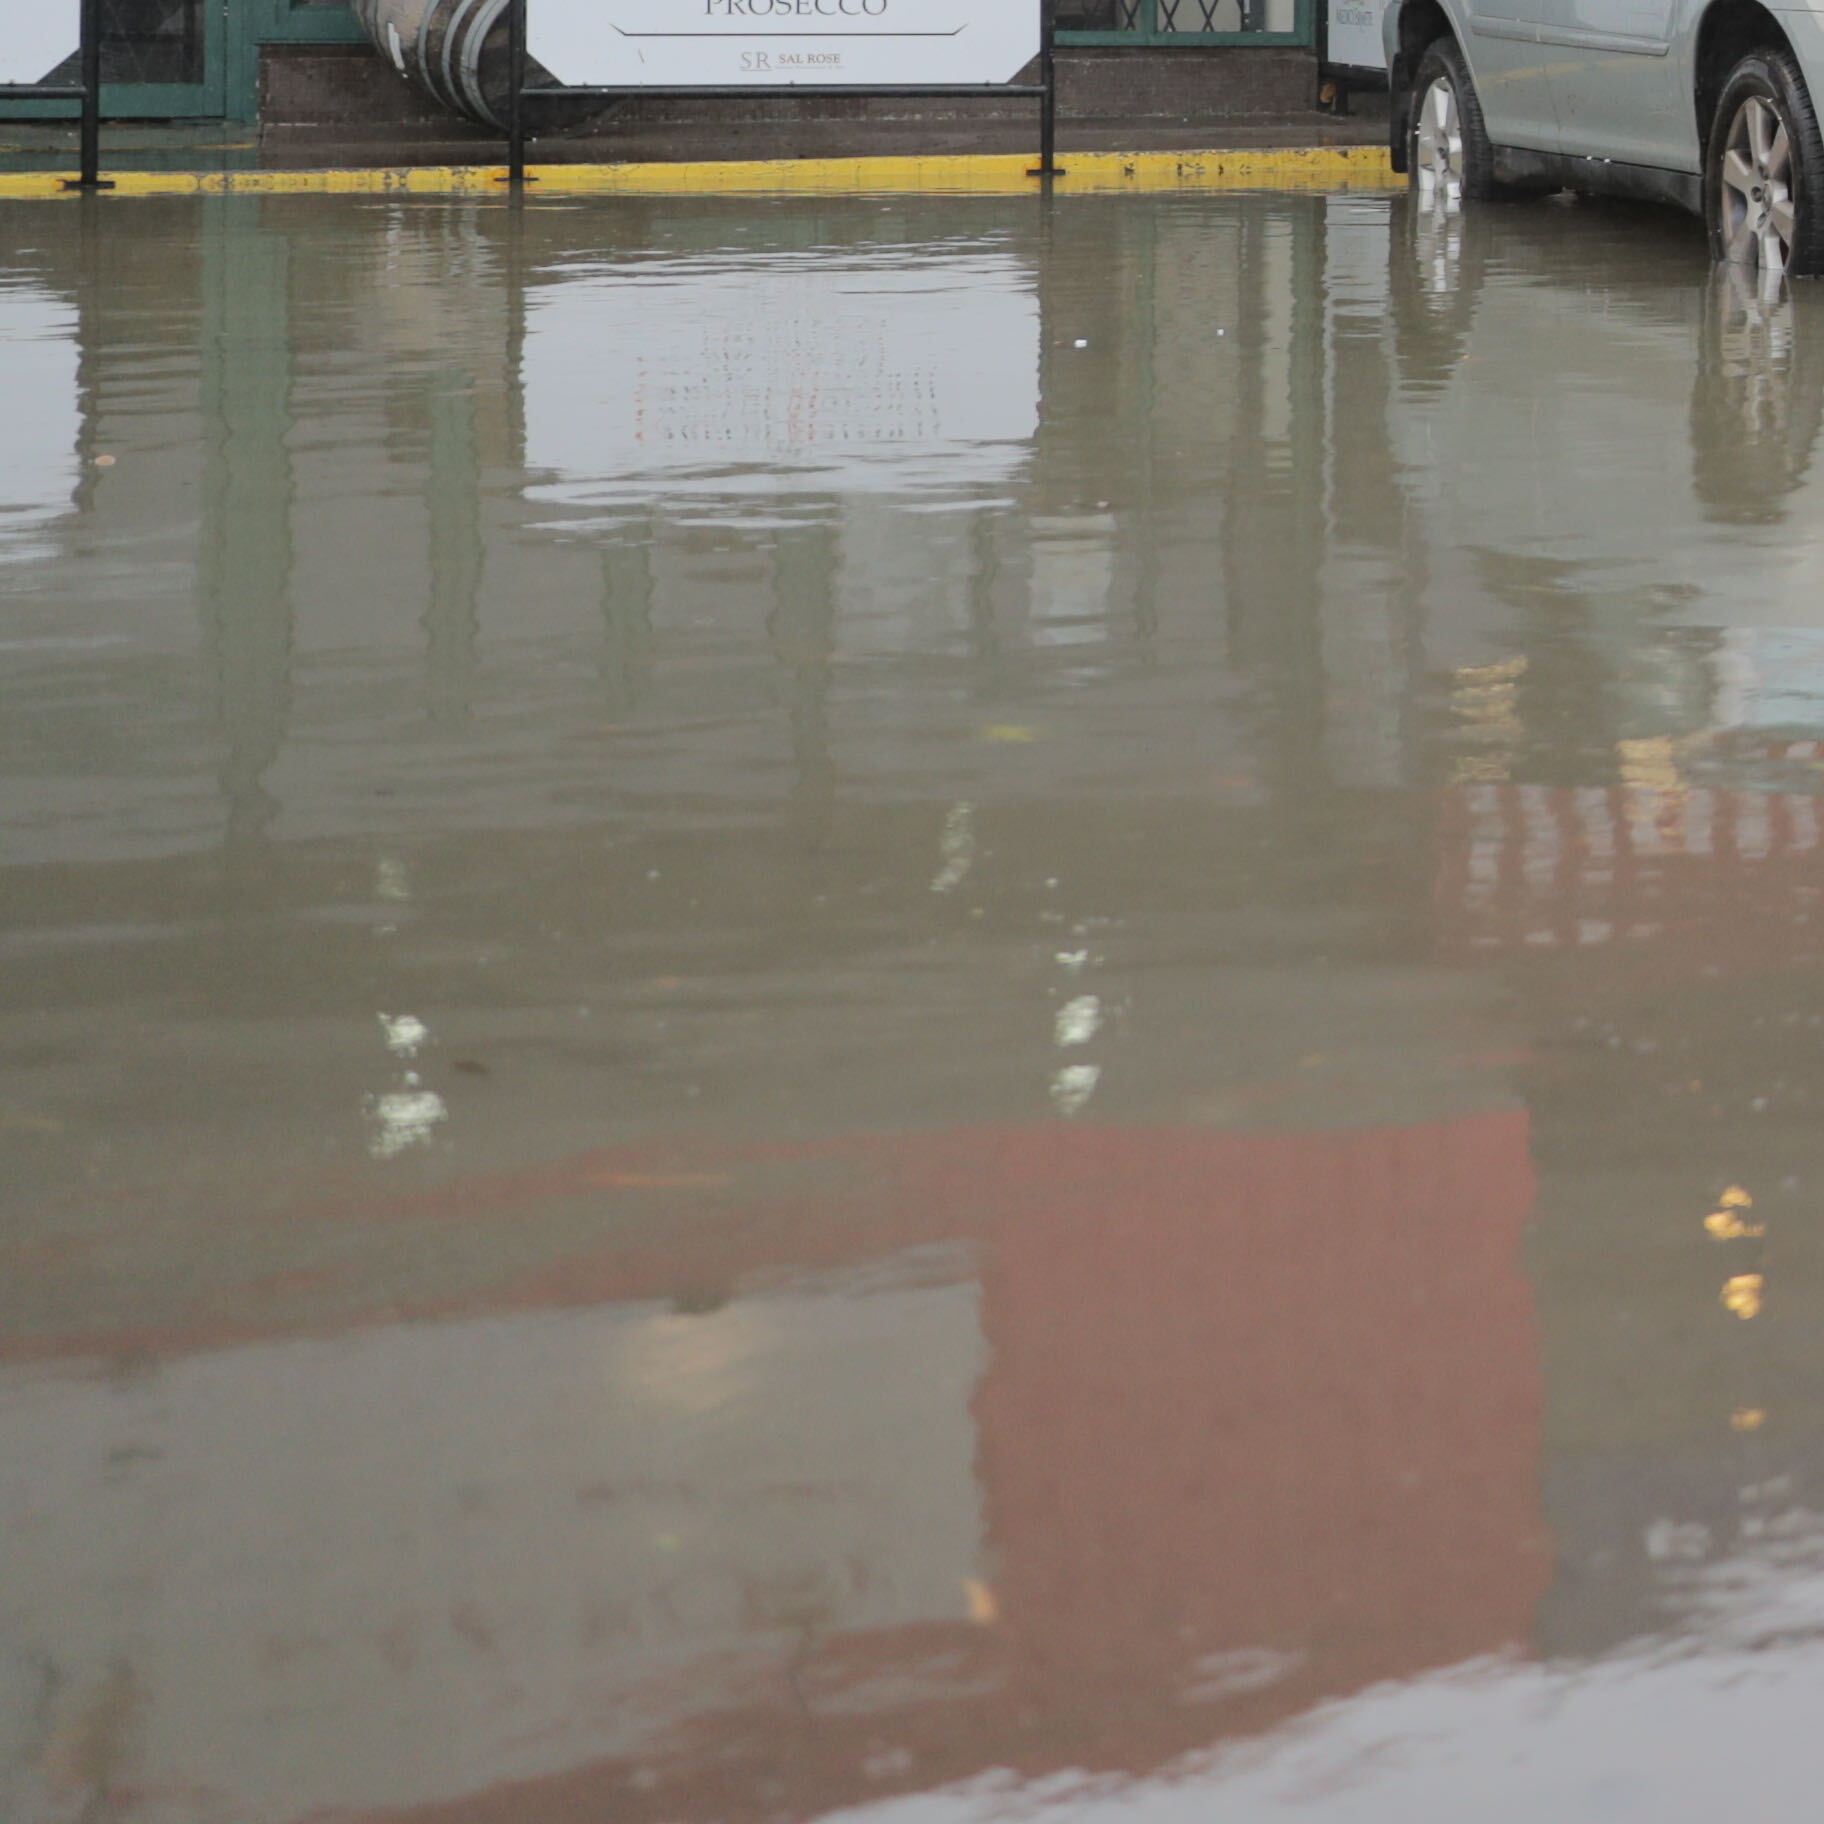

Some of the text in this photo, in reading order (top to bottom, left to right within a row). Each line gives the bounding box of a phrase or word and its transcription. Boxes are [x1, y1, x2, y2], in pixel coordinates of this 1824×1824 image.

[740, 51, 772, 71] SR
[778, 53, 804, 65] SAL
[807, 53, 842, 65] ROSE
